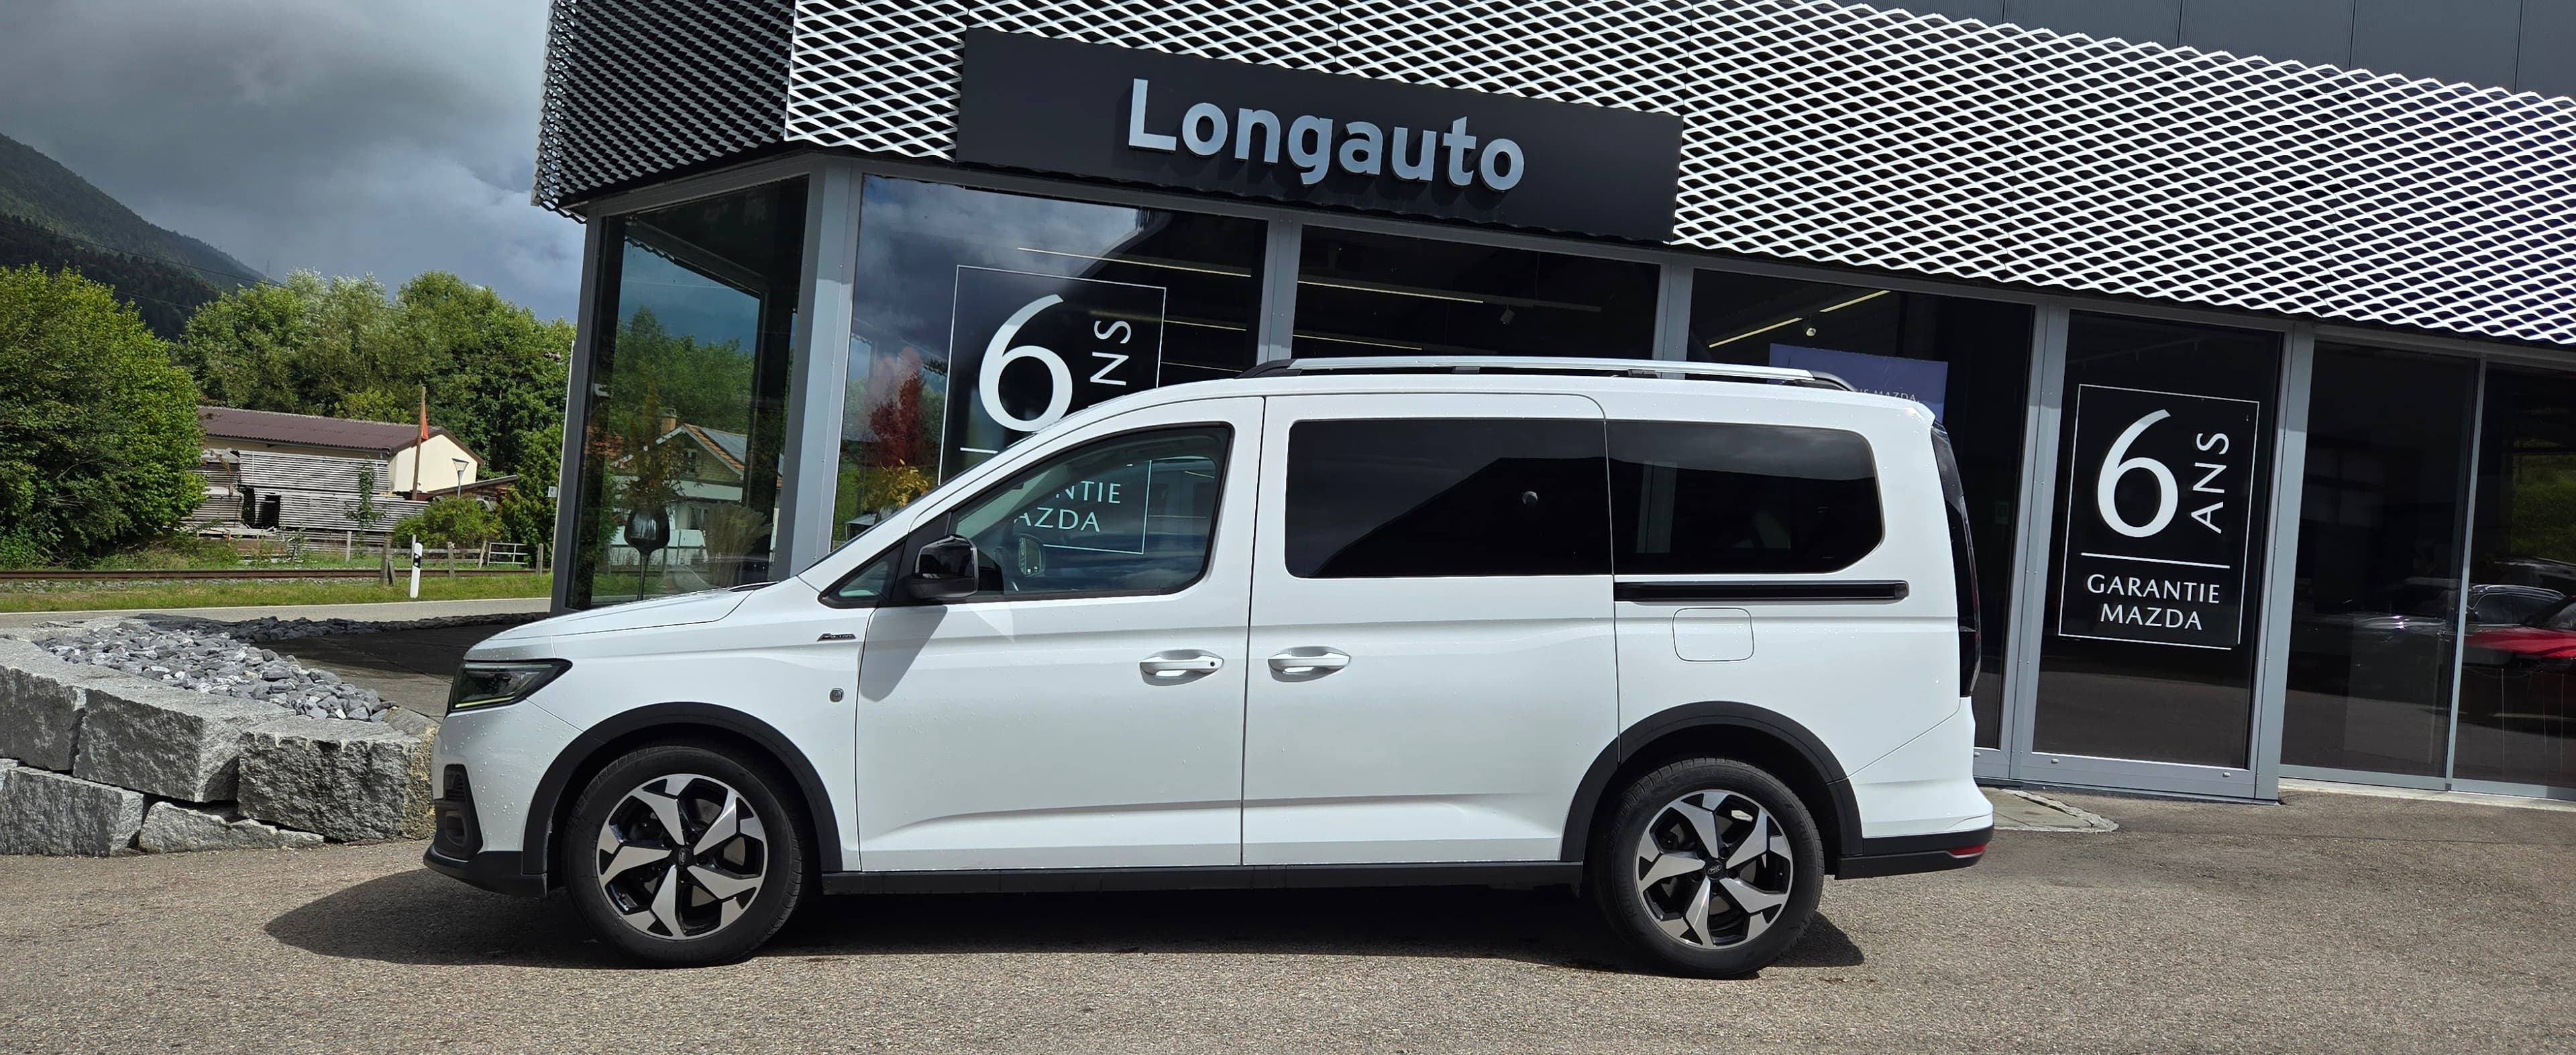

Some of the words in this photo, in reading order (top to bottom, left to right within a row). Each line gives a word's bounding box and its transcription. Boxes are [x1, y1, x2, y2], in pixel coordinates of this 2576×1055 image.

[1128, 78, 1525, 192] Longauto
[979, 294, 1073, 433] 6
[1089, 320, 1132, 386] NS
[2098, 409, 2178, 538] 6
[2191, 433, 2230, 534] ANS
[1014, 507, 1100, 532] AZDA
[2087, 574, 2220, 604] GARANTIE
[2100, 603, 2202, 631] MAZDA
